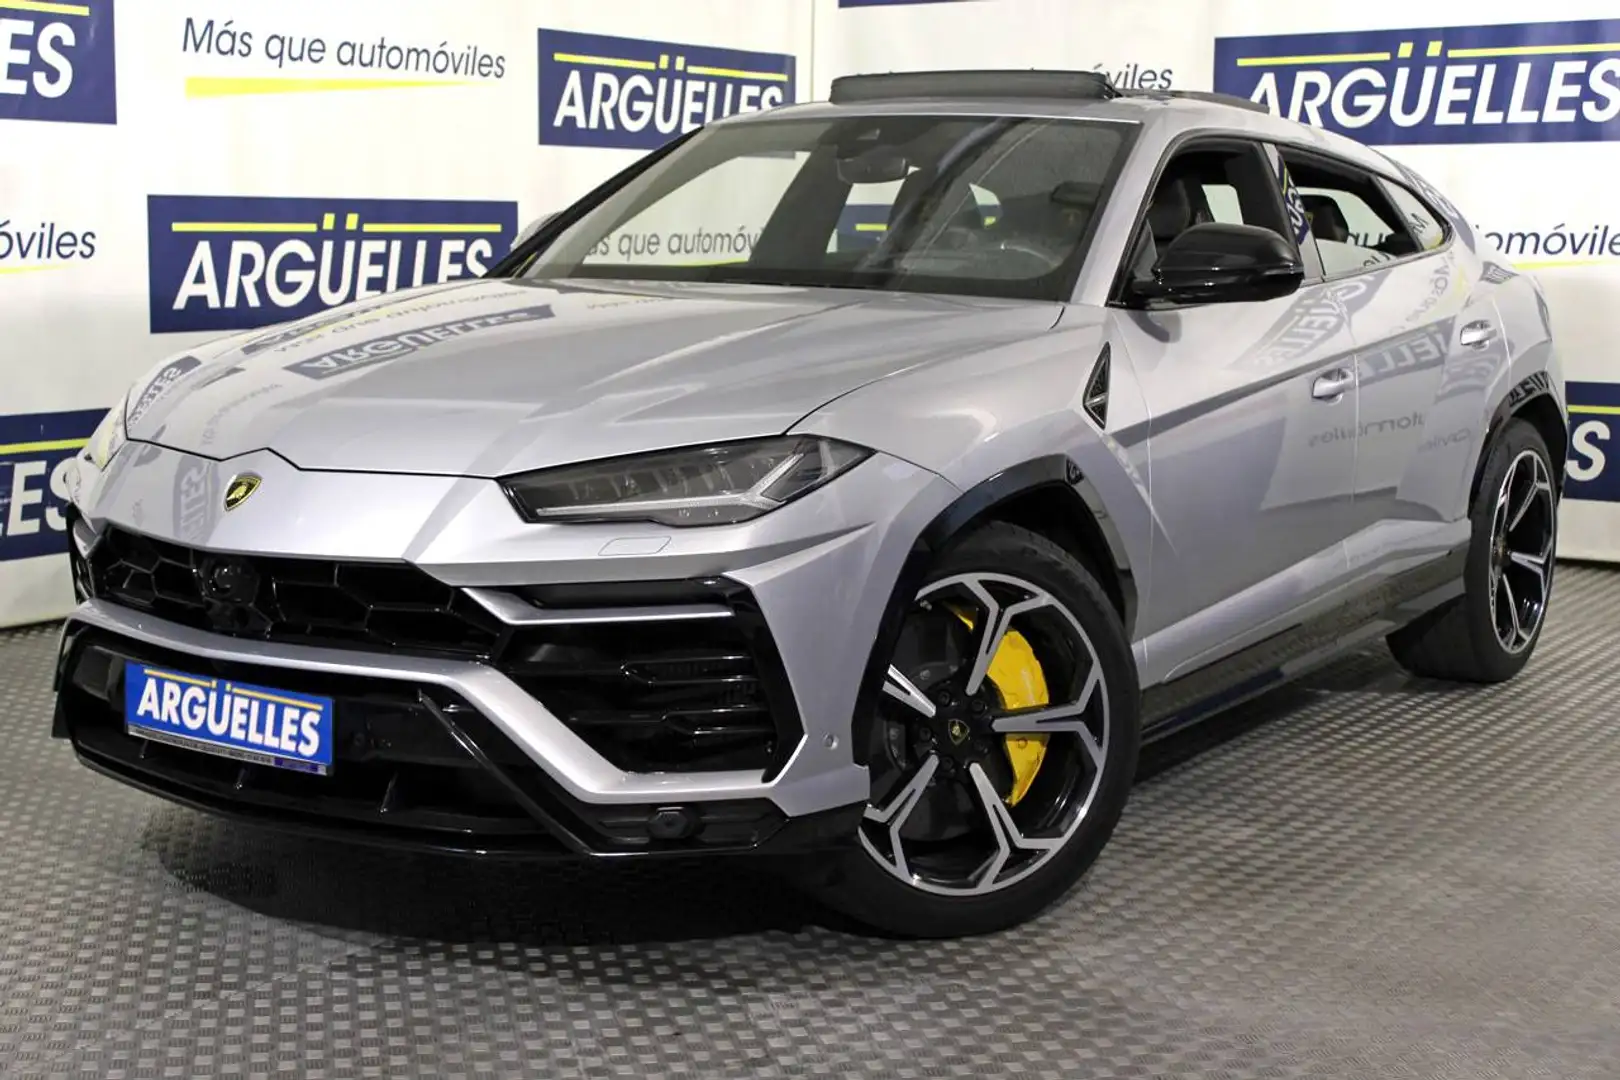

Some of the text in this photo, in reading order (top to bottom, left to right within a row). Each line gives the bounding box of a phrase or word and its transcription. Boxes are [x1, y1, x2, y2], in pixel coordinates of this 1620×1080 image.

[182, 17, 506, 79] Más que automóviles
[1094, 63, 1173, 89] viles
[618, 233, 660, 262] que
[668, 225, 764, 254] automóv
[136, 677, 322, 757] ARGÜELLES
